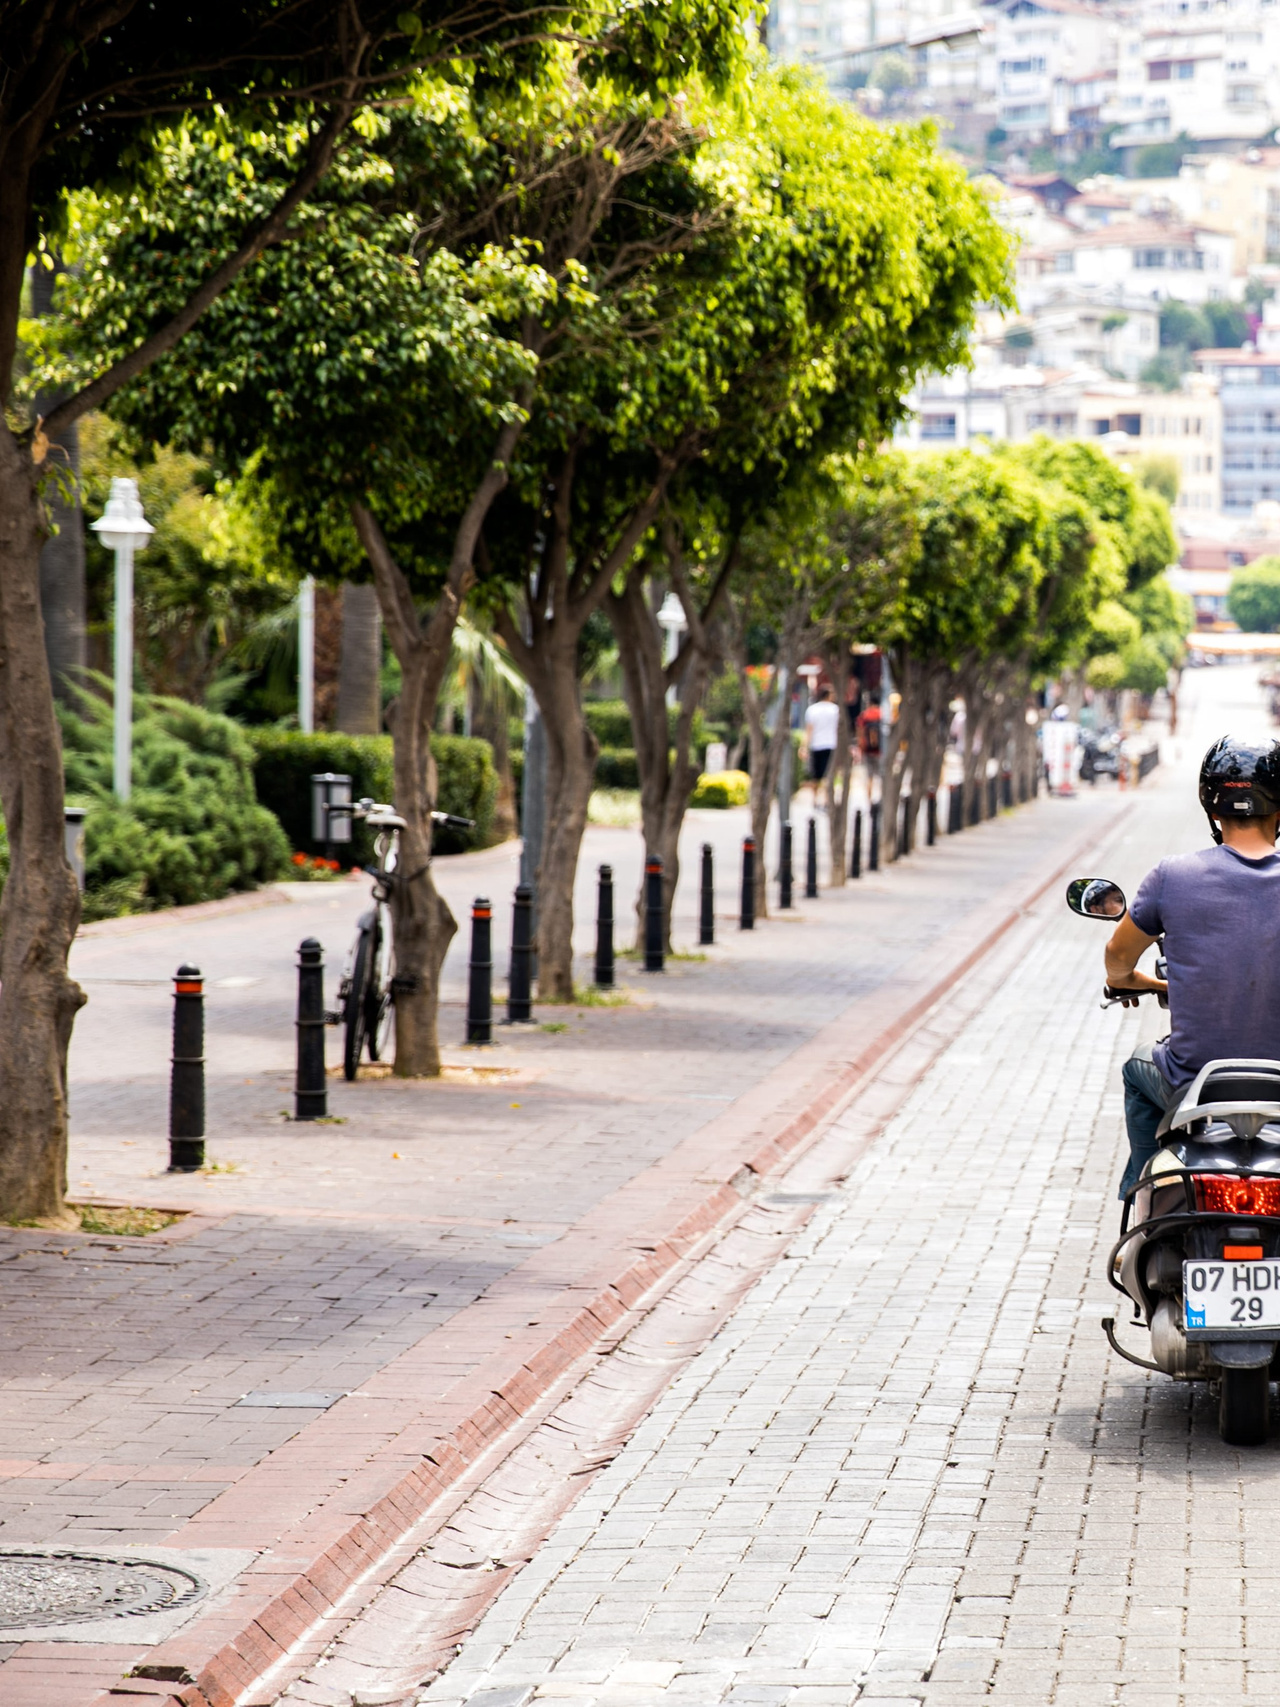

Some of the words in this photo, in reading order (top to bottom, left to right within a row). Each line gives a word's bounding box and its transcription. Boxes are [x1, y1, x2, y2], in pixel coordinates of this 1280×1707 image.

[1191, 1266, 1225, 1292] 07
[1190, 1317, 1204, 1327] TR
[1230, 1296, 1264, 1322] 29
